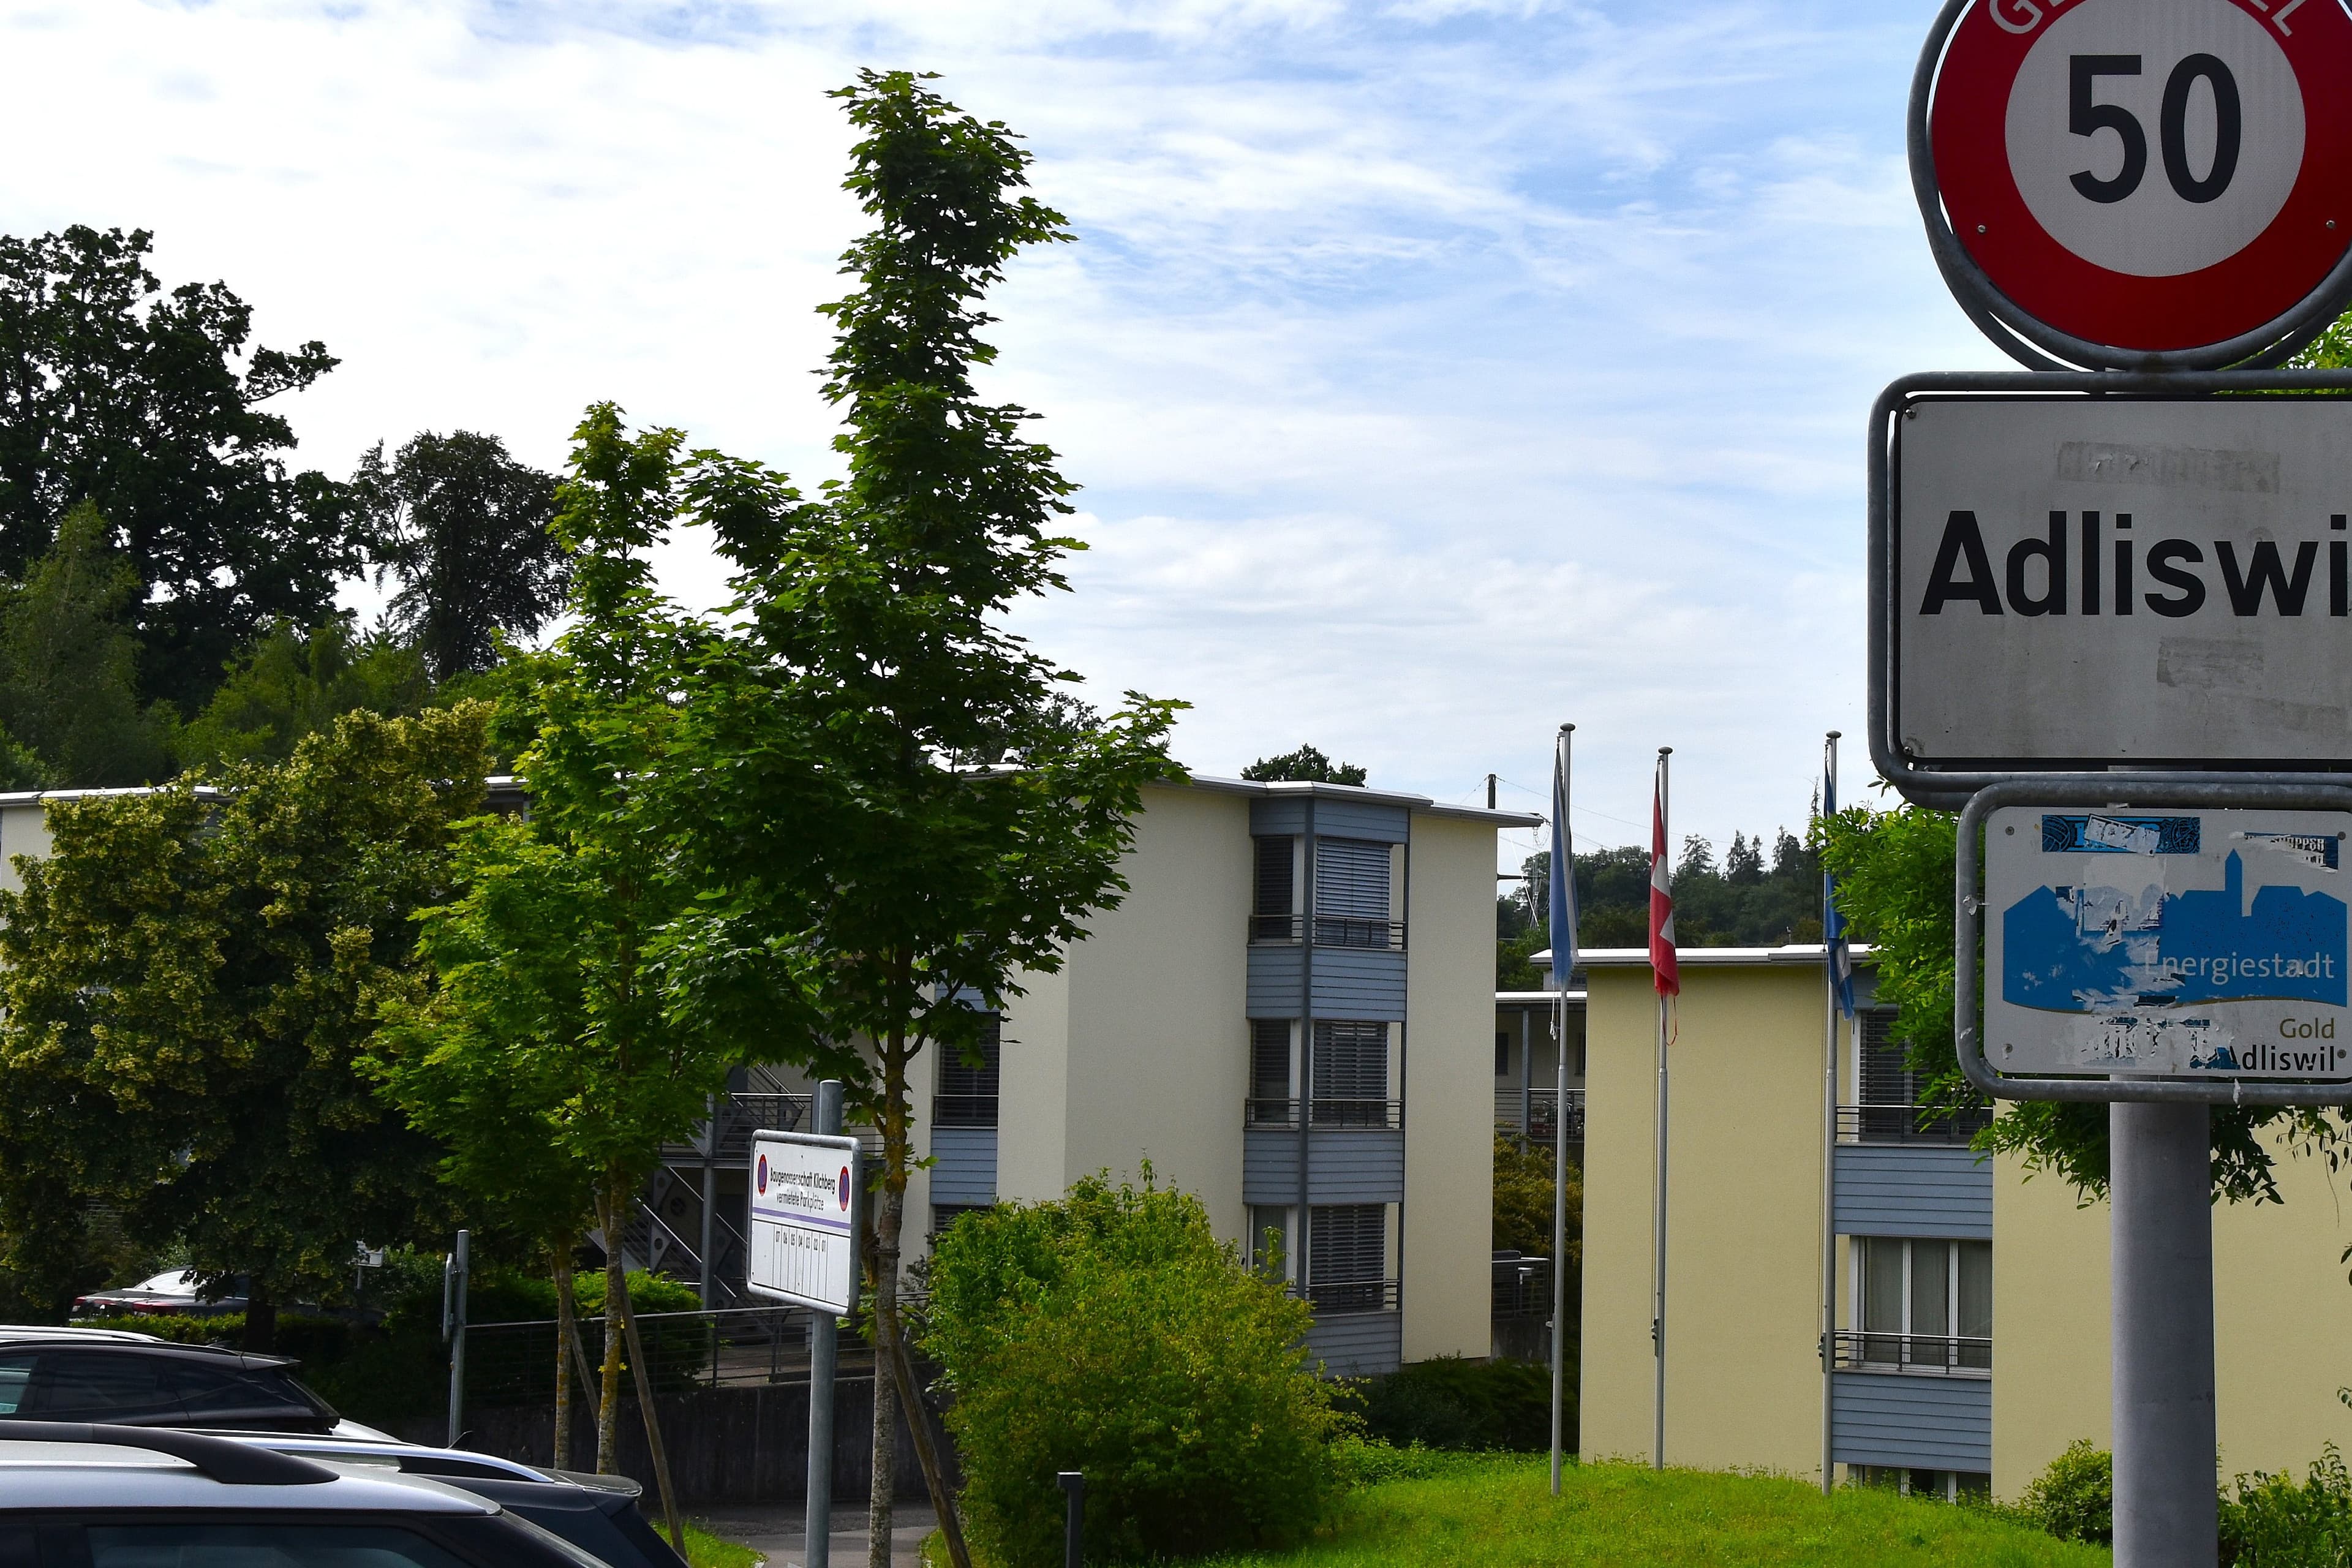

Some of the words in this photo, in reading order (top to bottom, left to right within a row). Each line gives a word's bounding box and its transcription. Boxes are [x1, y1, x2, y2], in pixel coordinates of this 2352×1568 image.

[2069, 53, 2241, 204] 50
[1919, 510, 2348, 617] Adliswi
[2145, 951, 2335, 985] Energiestadt
[2279, 1018, 2335, 1039] Gold
